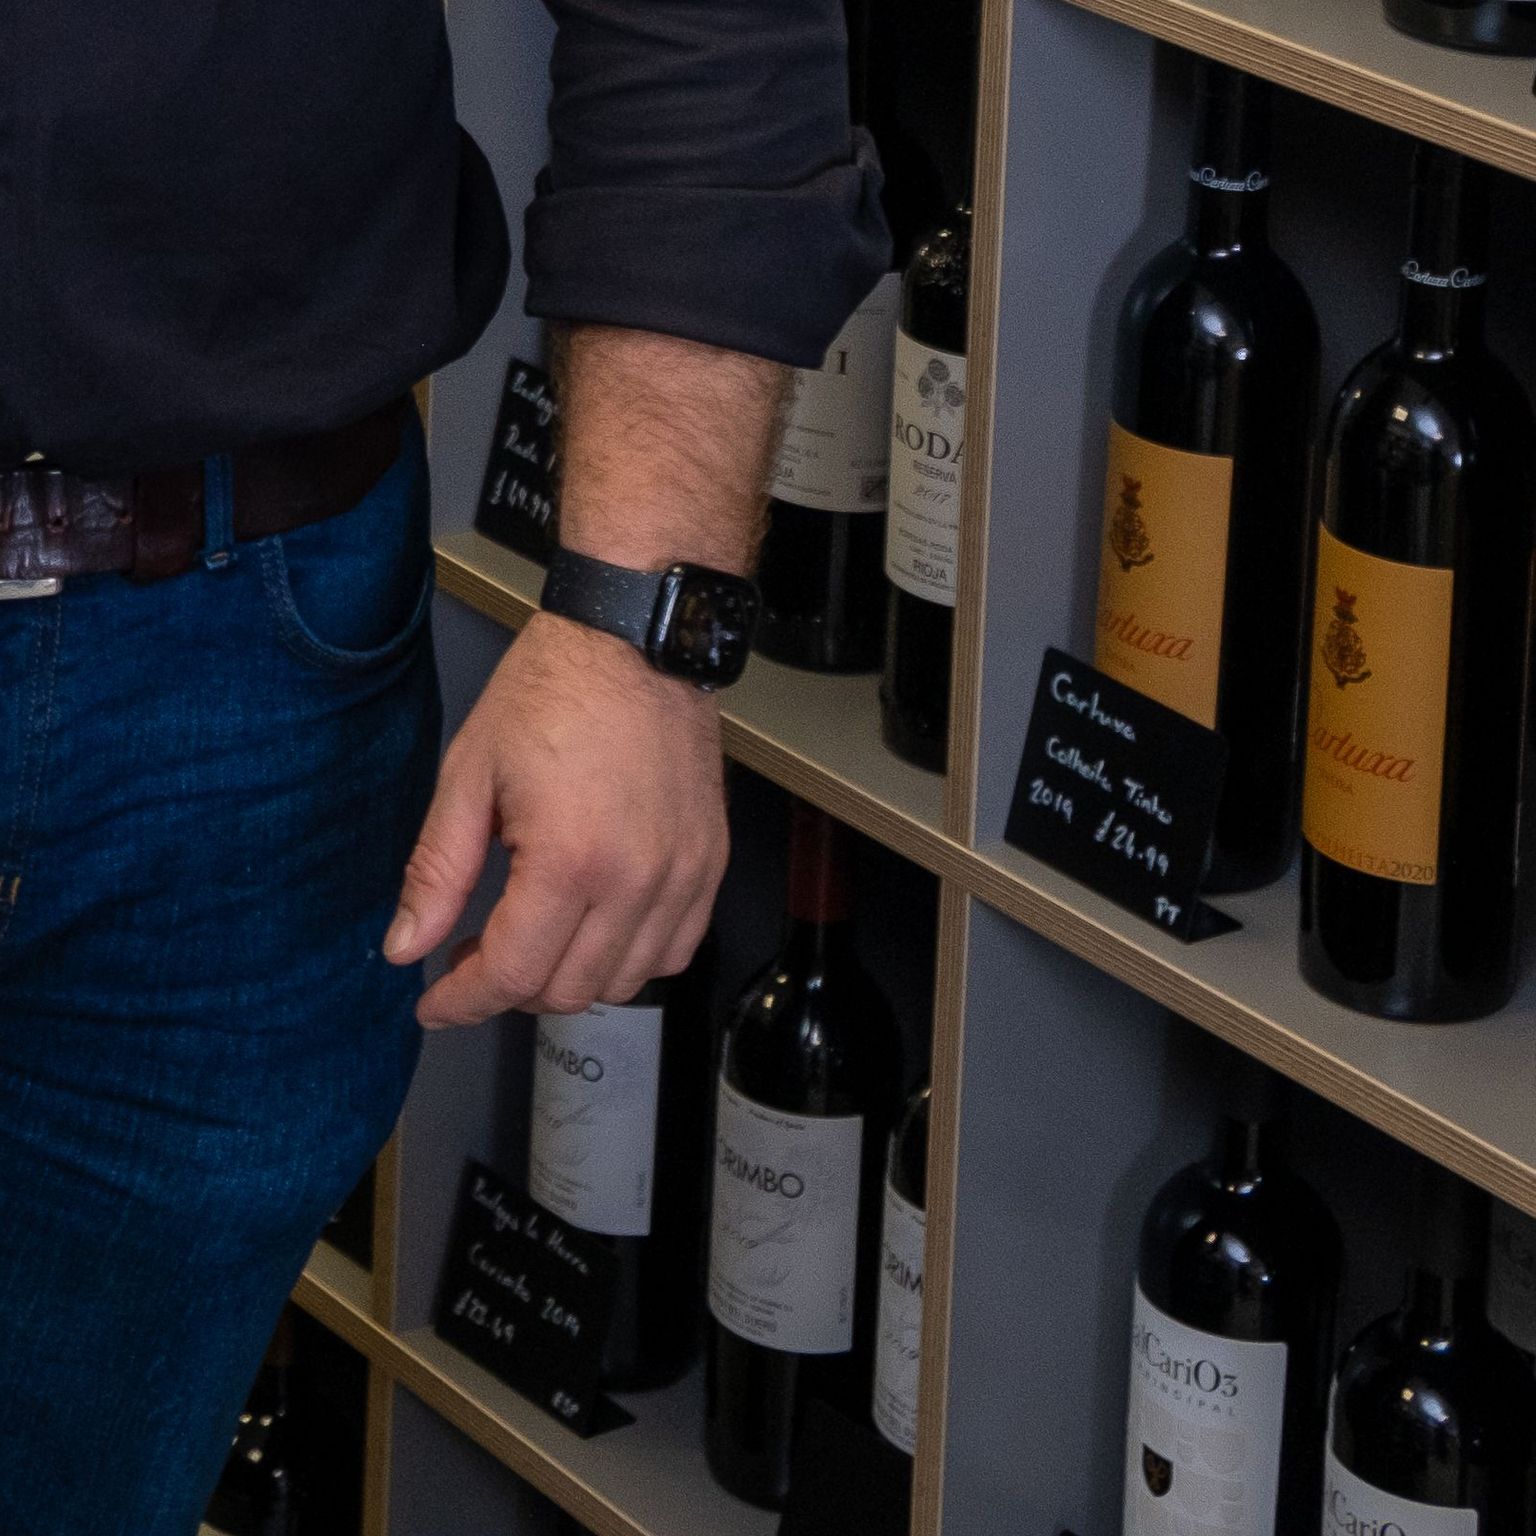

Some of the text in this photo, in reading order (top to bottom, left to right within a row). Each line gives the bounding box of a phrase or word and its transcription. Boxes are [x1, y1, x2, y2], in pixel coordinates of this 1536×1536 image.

[512, 371, 553, 427] Bodeg
[1105, 612, 1195, 661] rtuxa
[1310, 727, 1416, 784] artuxa
[1030, 779, 1073, 824] 2019
[719, 1136, 805, 1199] ORIMBO
